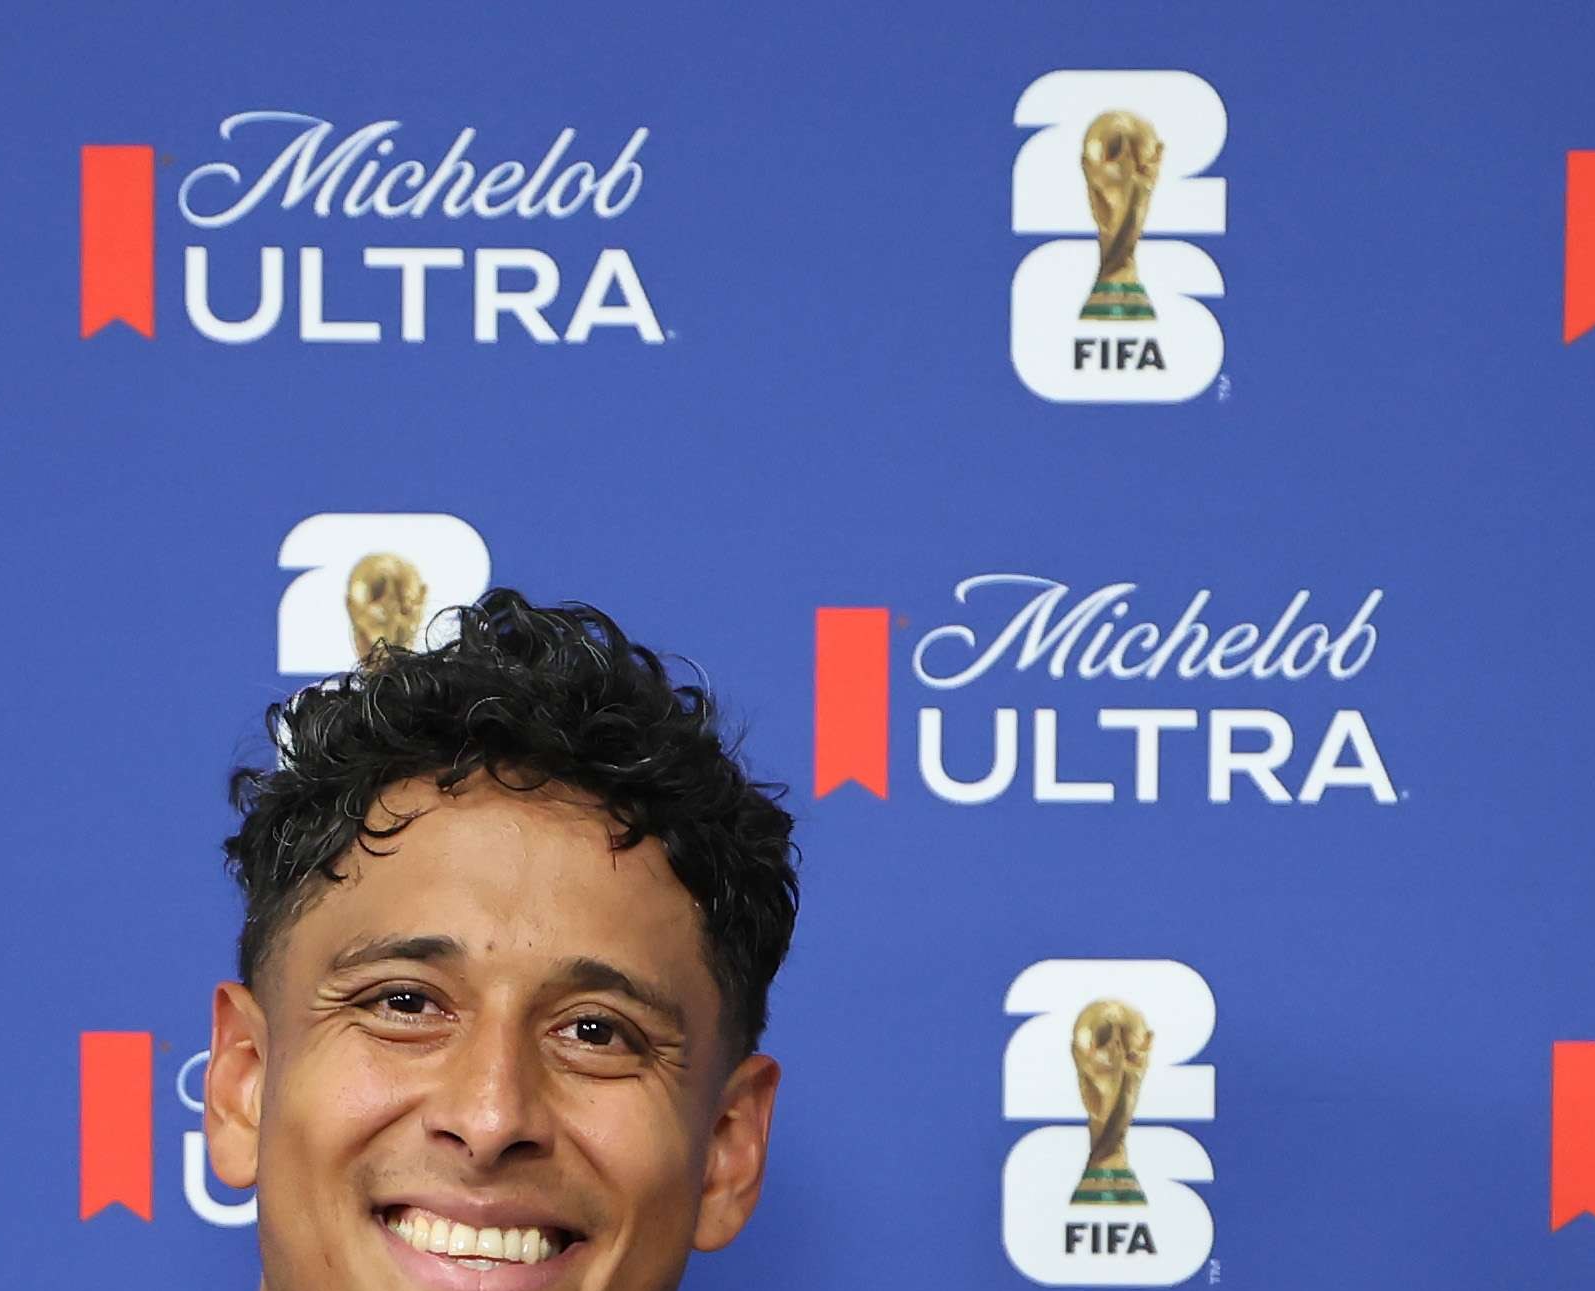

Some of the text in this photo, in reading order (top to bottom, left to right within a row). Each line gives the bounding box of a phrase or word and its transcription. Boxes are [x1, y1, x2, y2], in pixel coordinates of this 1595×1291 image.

[179, 112, 649, 227] Michelob
[185, 246, 665, 344] ULTRA
[1073, 338, 1166, 371] FIFA
[913, 574, 1383, 688] Michelob
[919, 708, 1397, 804] ULTRA
[1064, 1222, 1157, 1255] FIFA
